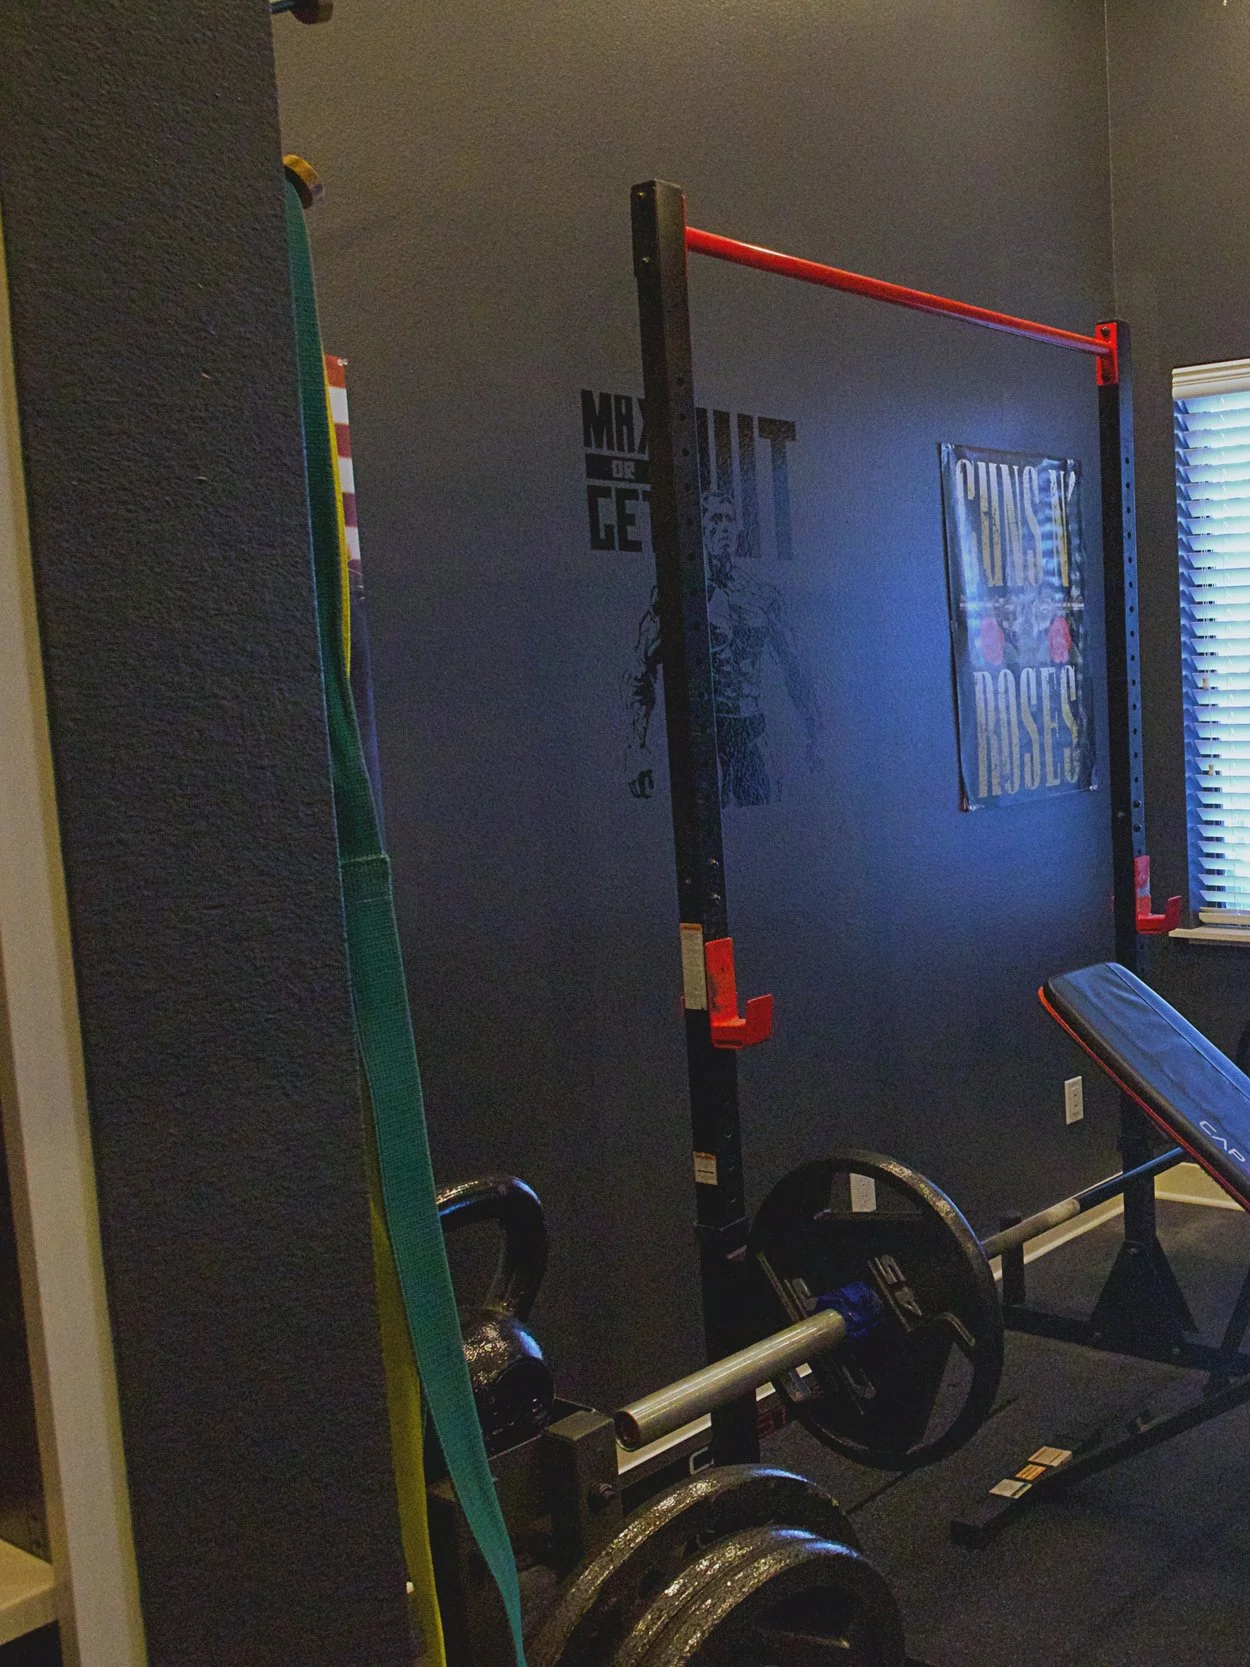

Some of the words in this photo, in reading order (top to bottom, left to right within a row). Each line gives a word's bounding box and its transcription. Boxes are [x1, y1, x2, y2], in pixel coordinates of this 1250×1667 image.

[611, 457, 636, 481] OR
[587, 484, 651, 552] GE
[956, 459, 1044, 588] GUNS
[973, 665, 1081, 798] ROSES
[1200, 1120, 1246, 1163] CAP
